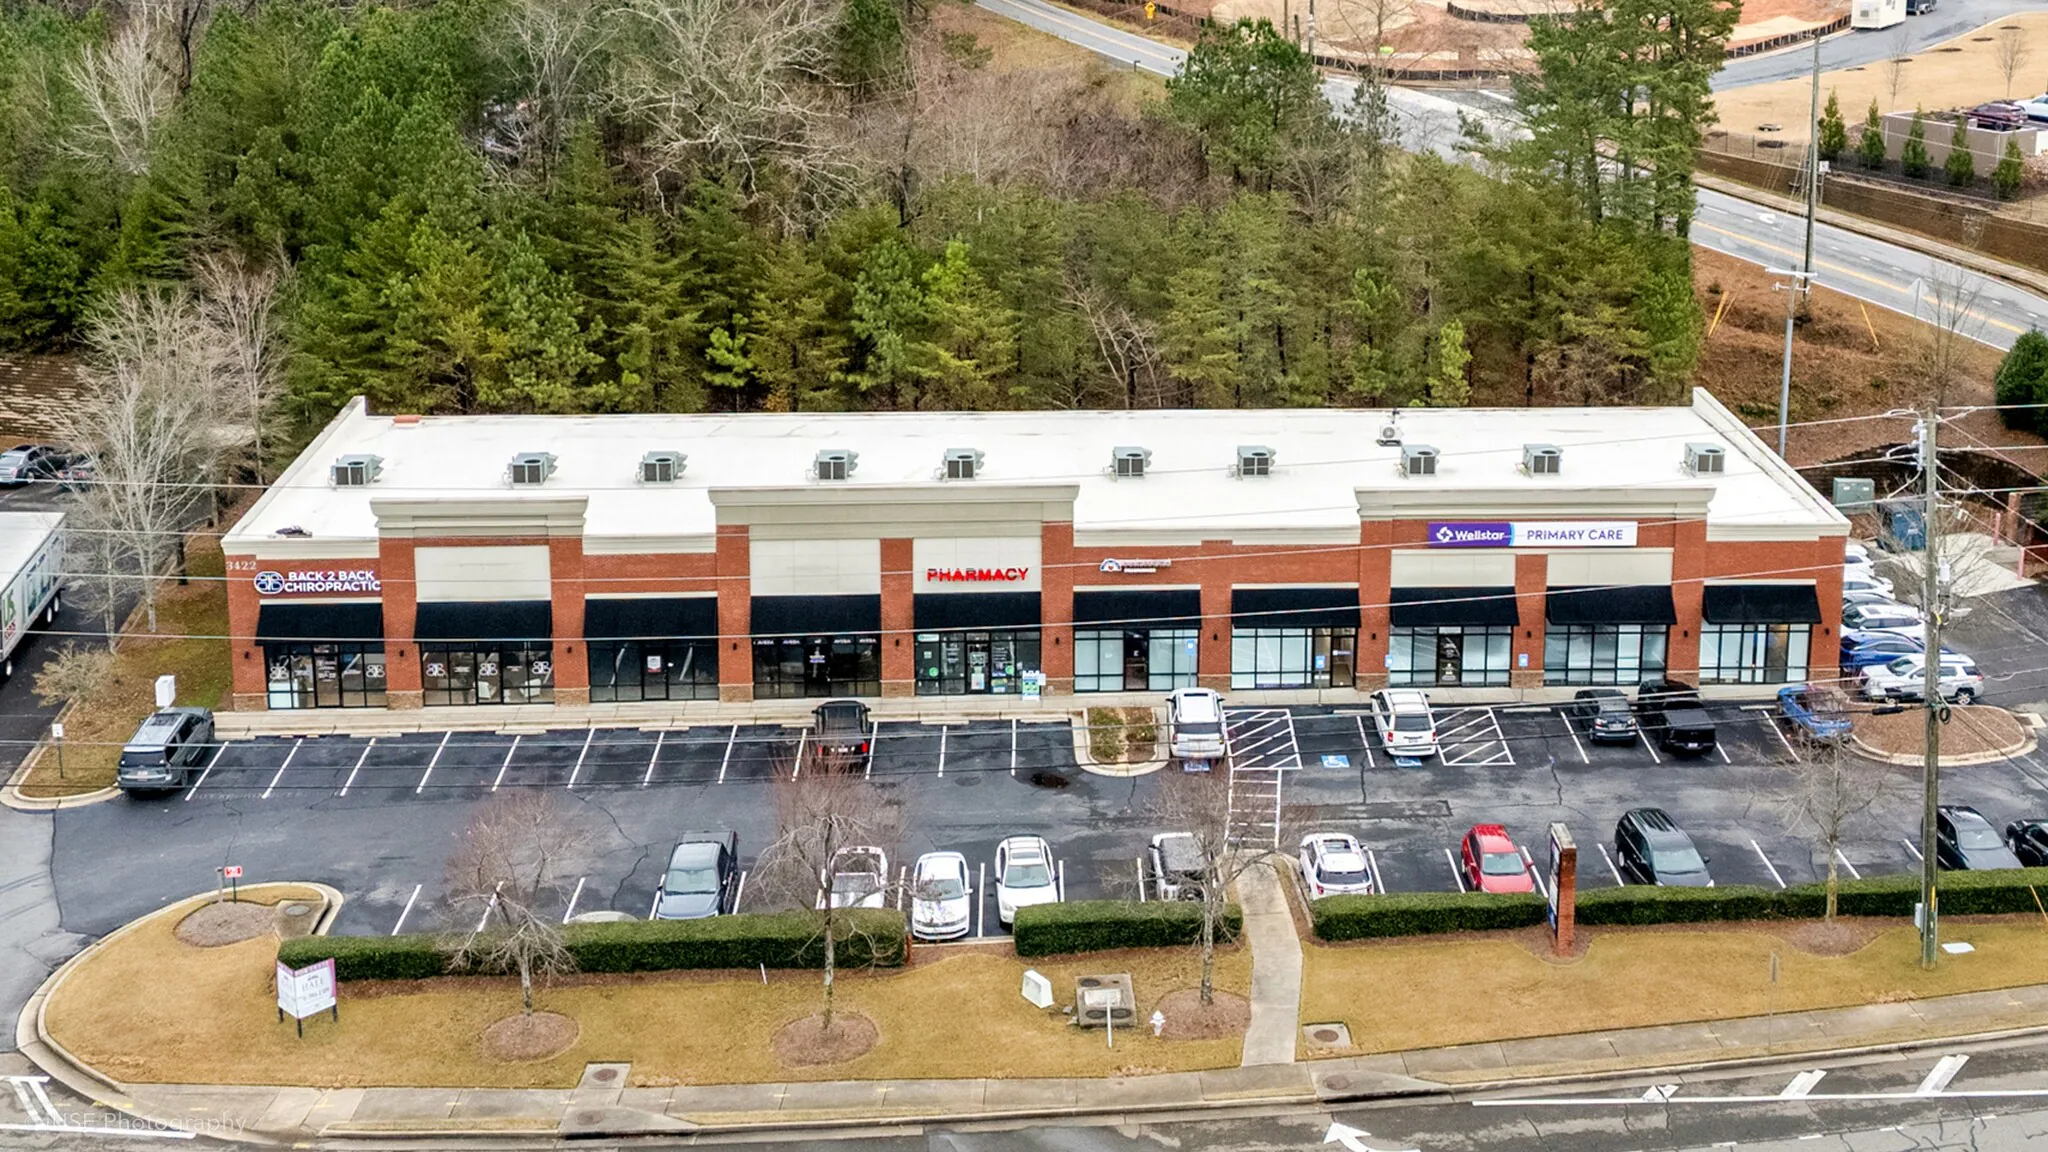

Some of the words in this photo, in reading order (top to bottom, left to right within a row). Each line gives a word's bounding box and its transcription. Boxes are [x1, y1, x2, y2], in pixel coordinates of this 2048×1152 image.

[1455, 530, 1505, 542] Wellstar
[1527, 529, 1584, 541] PRIMARY
[1587, 529, 1624, 541] CARE
[226, 561, 256, 571] 3422
[288, 571, 325, 582] BACK
[327, 571, 336, 582] 2
[338, 570, 375, 582] BACK
[927, 567, 1029, 582] PHARMACY
[284, 581, 381, 592] CHIROPRACTIC
